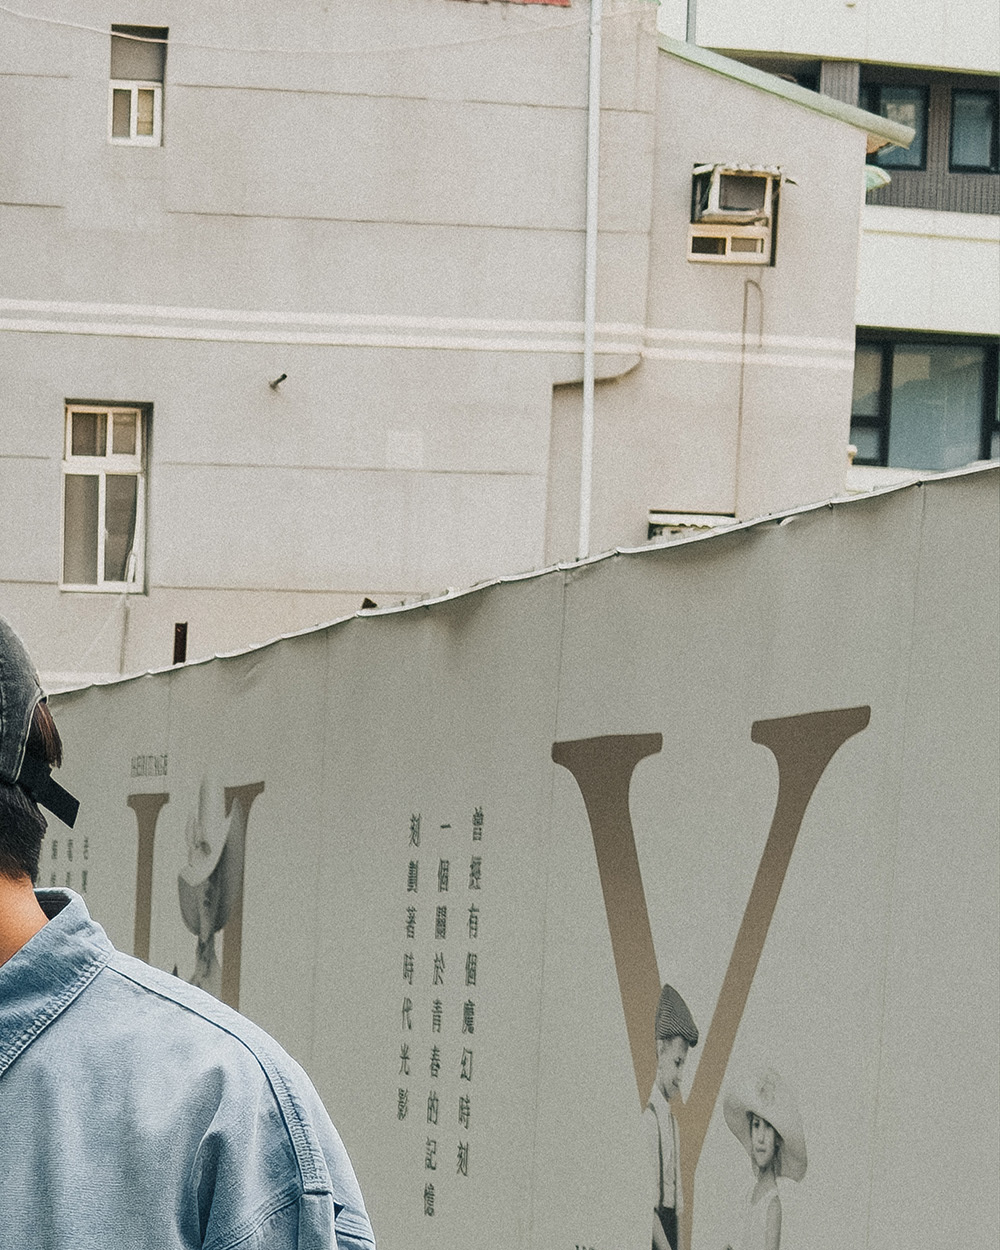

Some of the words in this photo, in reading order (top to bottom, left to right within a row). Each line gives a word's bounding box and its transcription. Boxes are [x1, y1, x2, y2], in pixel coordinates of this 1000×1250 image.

[397, 812, 422, 1122] 刻劃著時代光影
[423, 823, 452, 1217] 一個關於青春的記憶
[456, 805, 485, 1177] 曾經有個魔幻時刻
